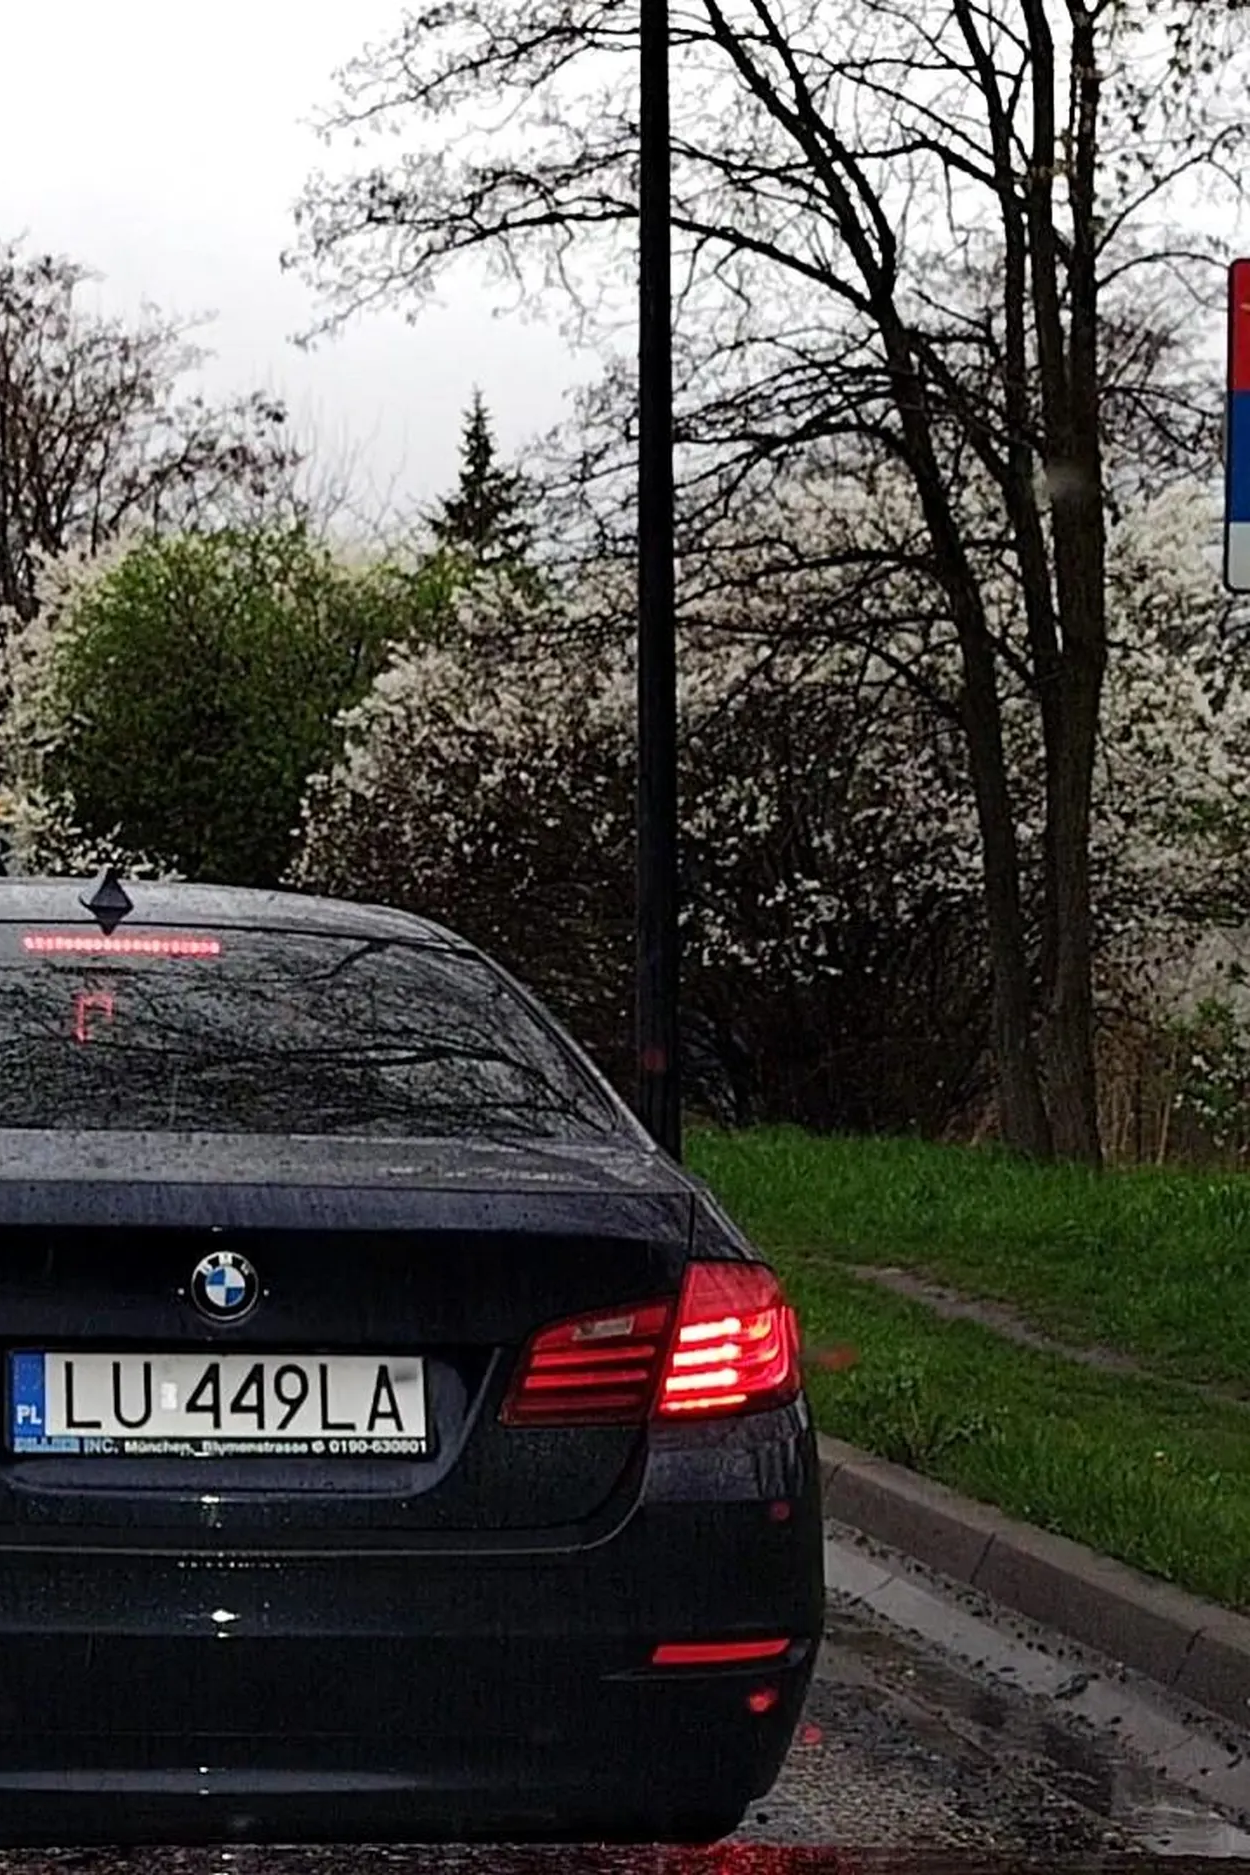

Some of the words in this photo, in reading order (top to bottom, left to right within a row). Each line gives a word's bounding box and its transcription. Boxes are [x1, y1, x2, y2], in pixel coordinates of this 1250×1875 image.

[197, 1251, 251, 1276] BMW
[64, 1361, 152, 1430] LU
[185, 1362, 405, 1432] 449LA
[16, 1404, 43, 1425] PL
